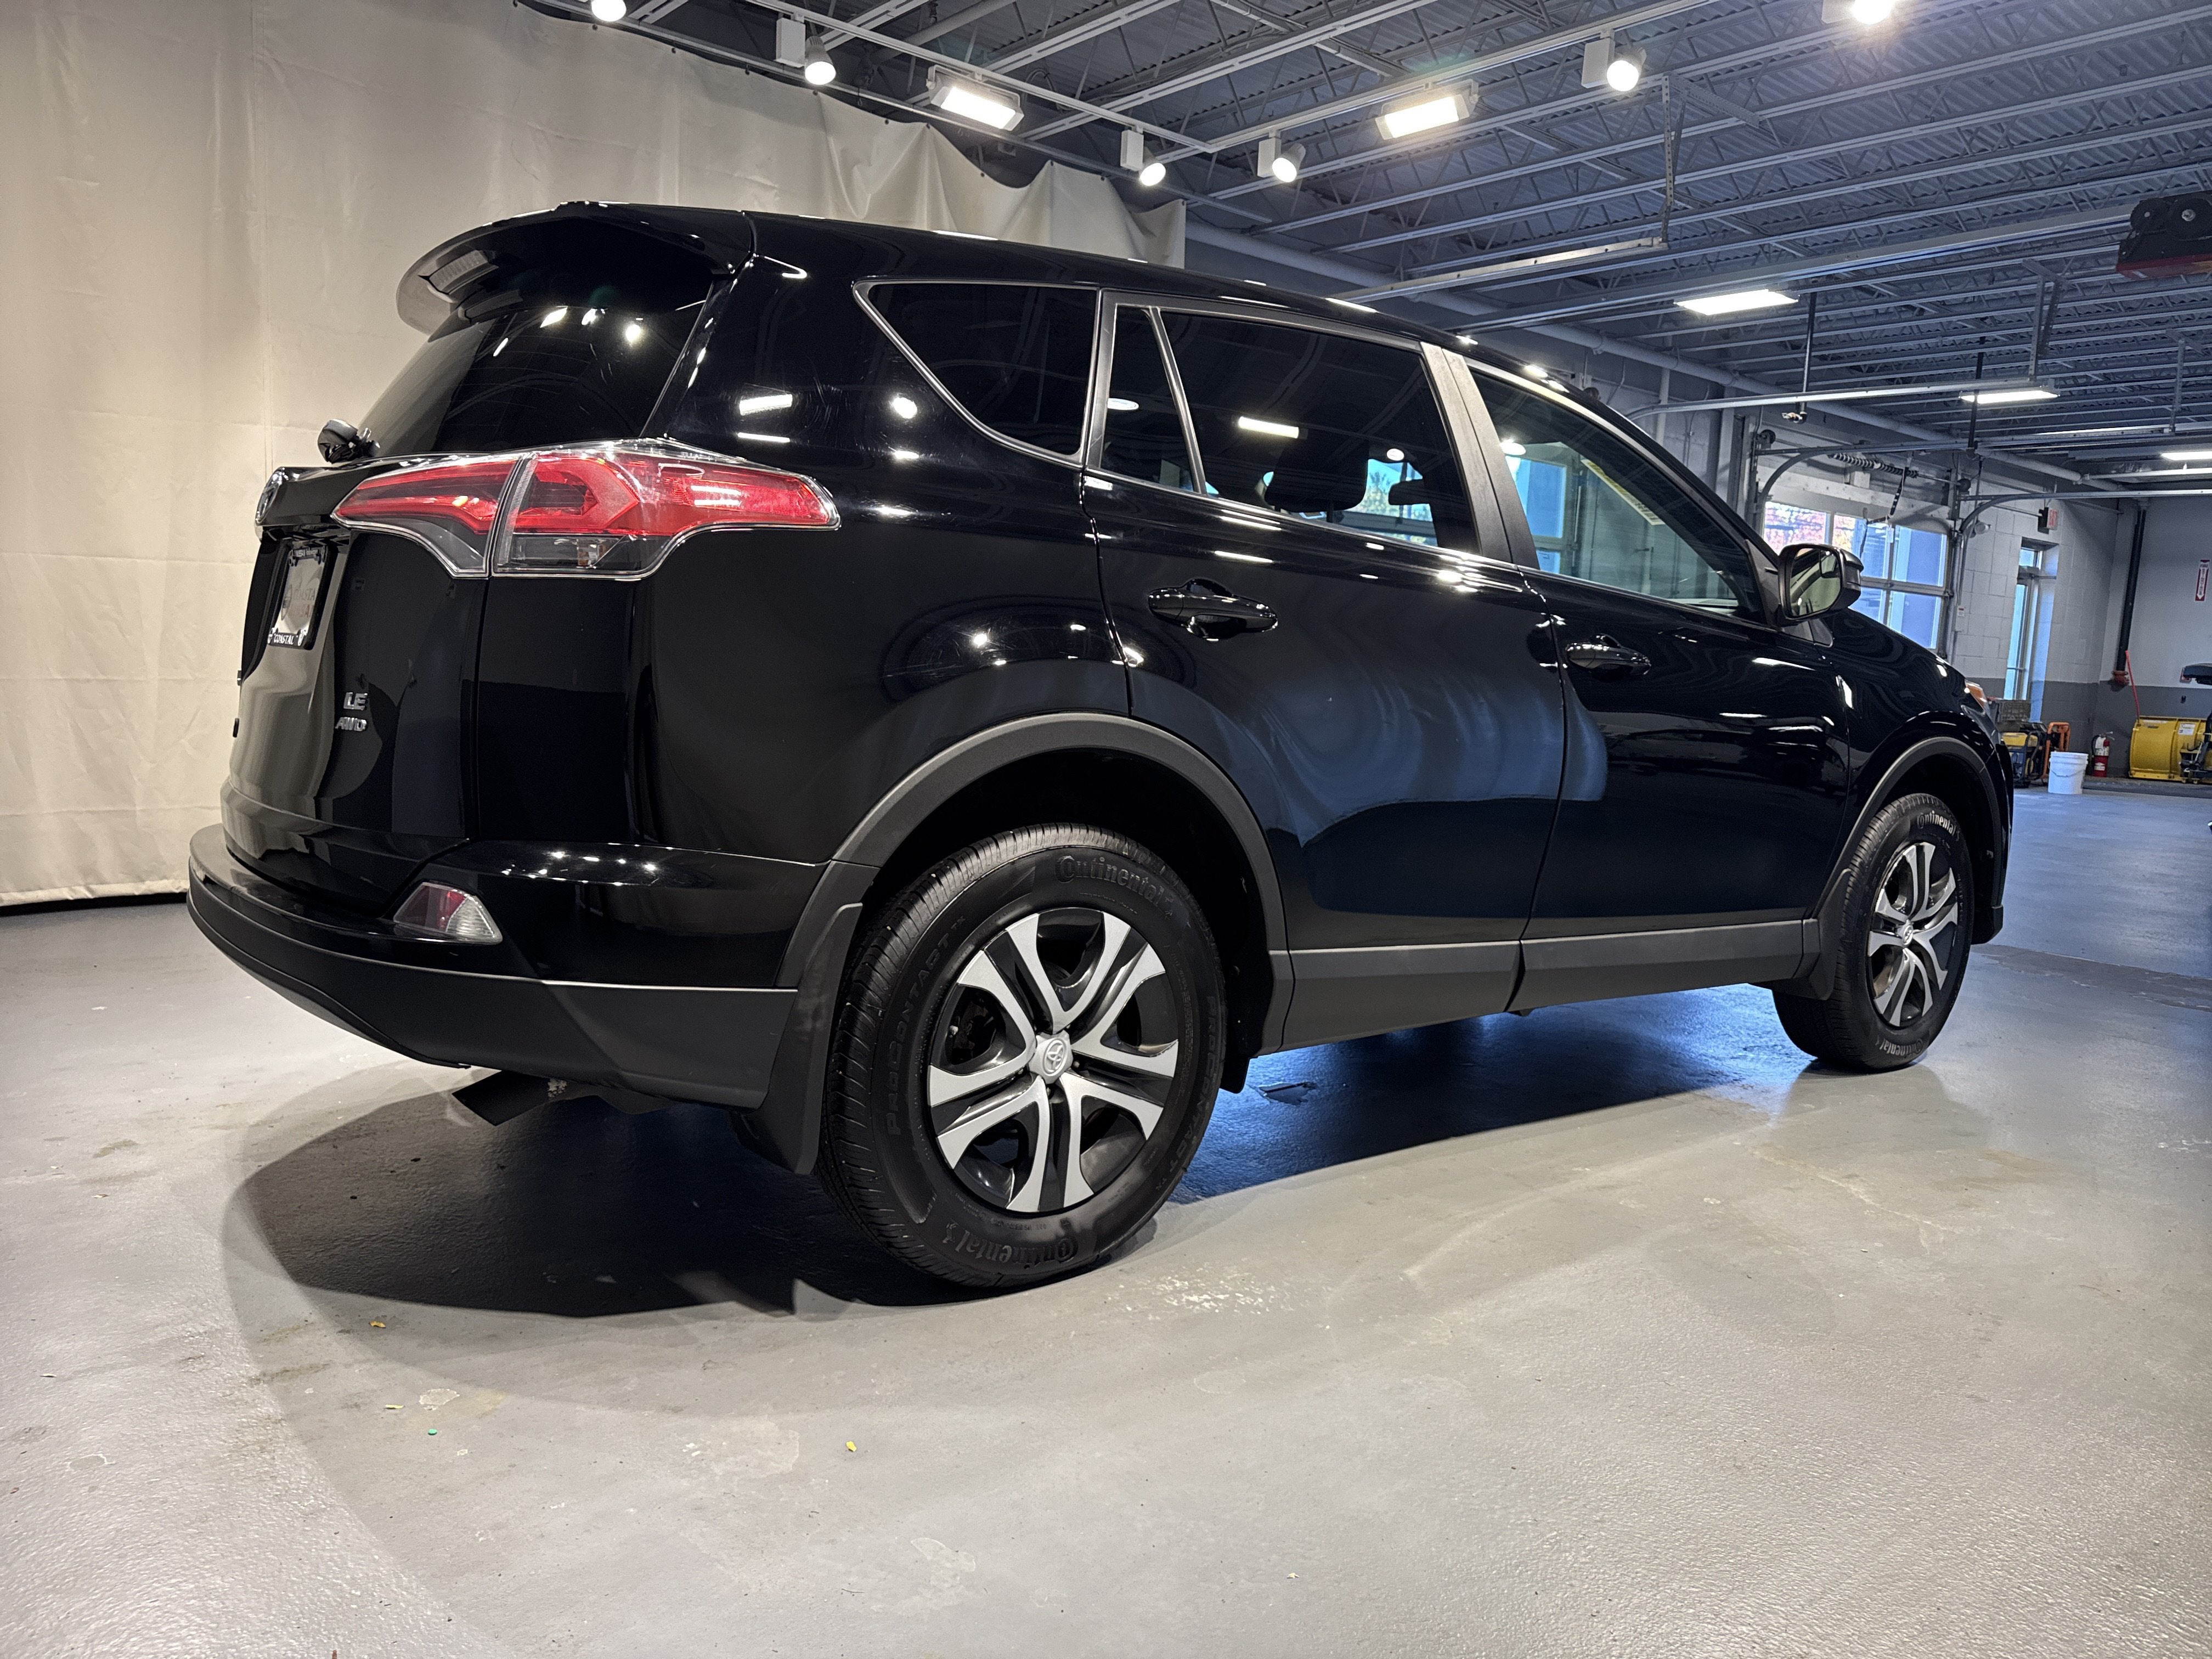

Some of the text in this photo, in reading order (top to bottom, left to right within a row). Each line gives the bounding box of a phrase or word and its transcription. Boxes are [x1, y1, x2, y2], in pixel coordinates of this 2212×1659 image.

[274, 634, 294, 645] COASTAL
[343, 692, 368, 710] LE
[335, 716, 367, 731] AWD
[1917, 810, 1957, 836] Continental
[1054, 855, 1165, 907] Continental
[954, 1229, 1079, 1269] Continental
